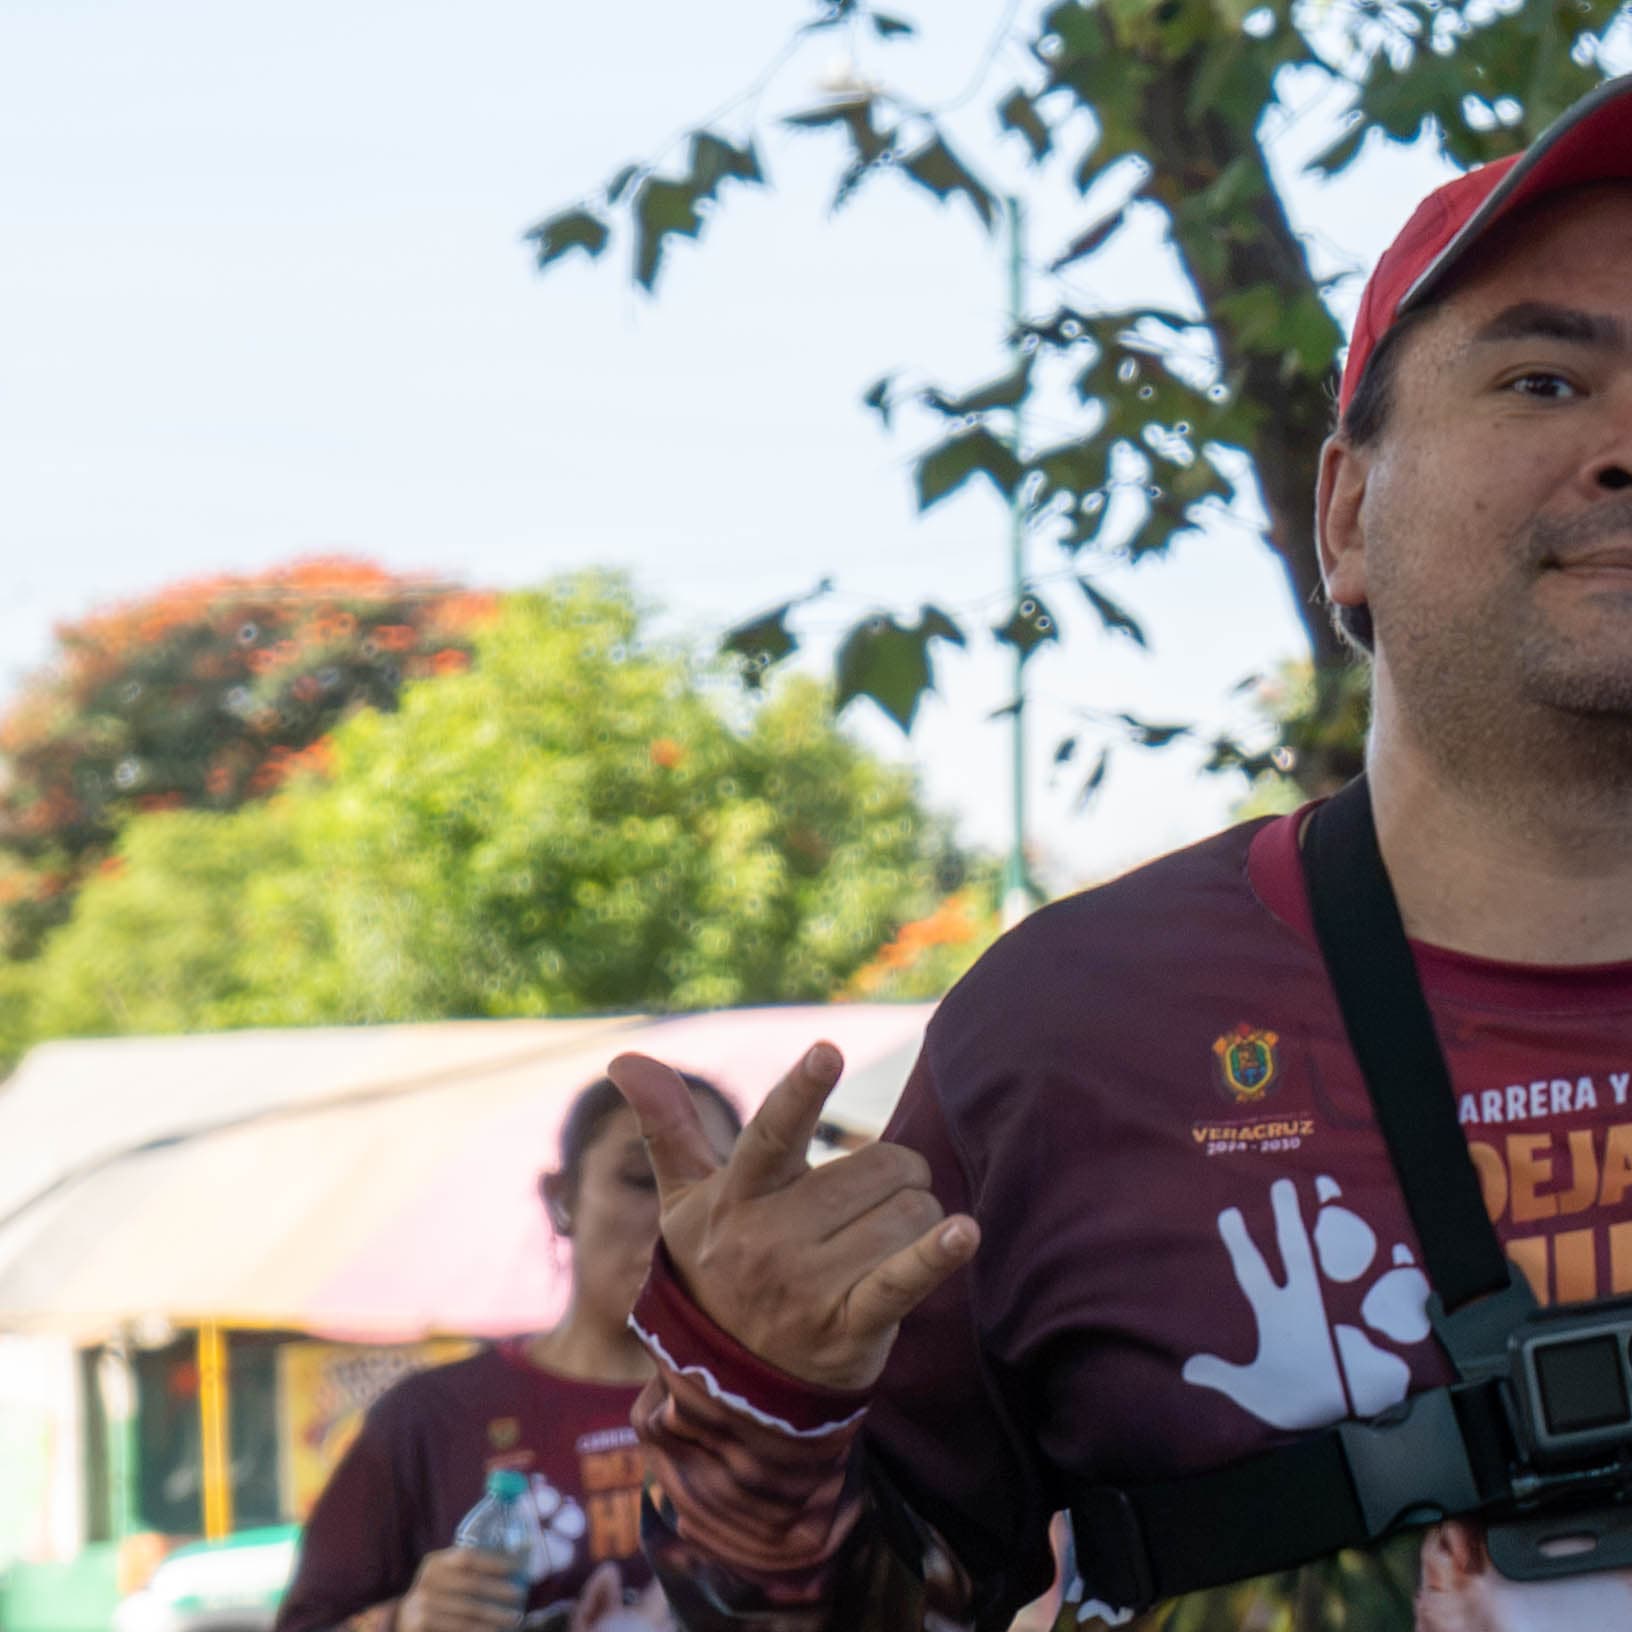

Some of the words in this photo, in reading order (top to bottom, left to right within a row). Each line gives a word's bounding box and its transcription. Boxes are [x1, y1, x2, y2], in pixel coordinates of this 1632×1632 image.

[1458, 1076, 1597, 1124] ARRERA
[1609, 1072, 1630, 1104] Y
[1192, 1120, 1314, 1143] VERACRUZ
